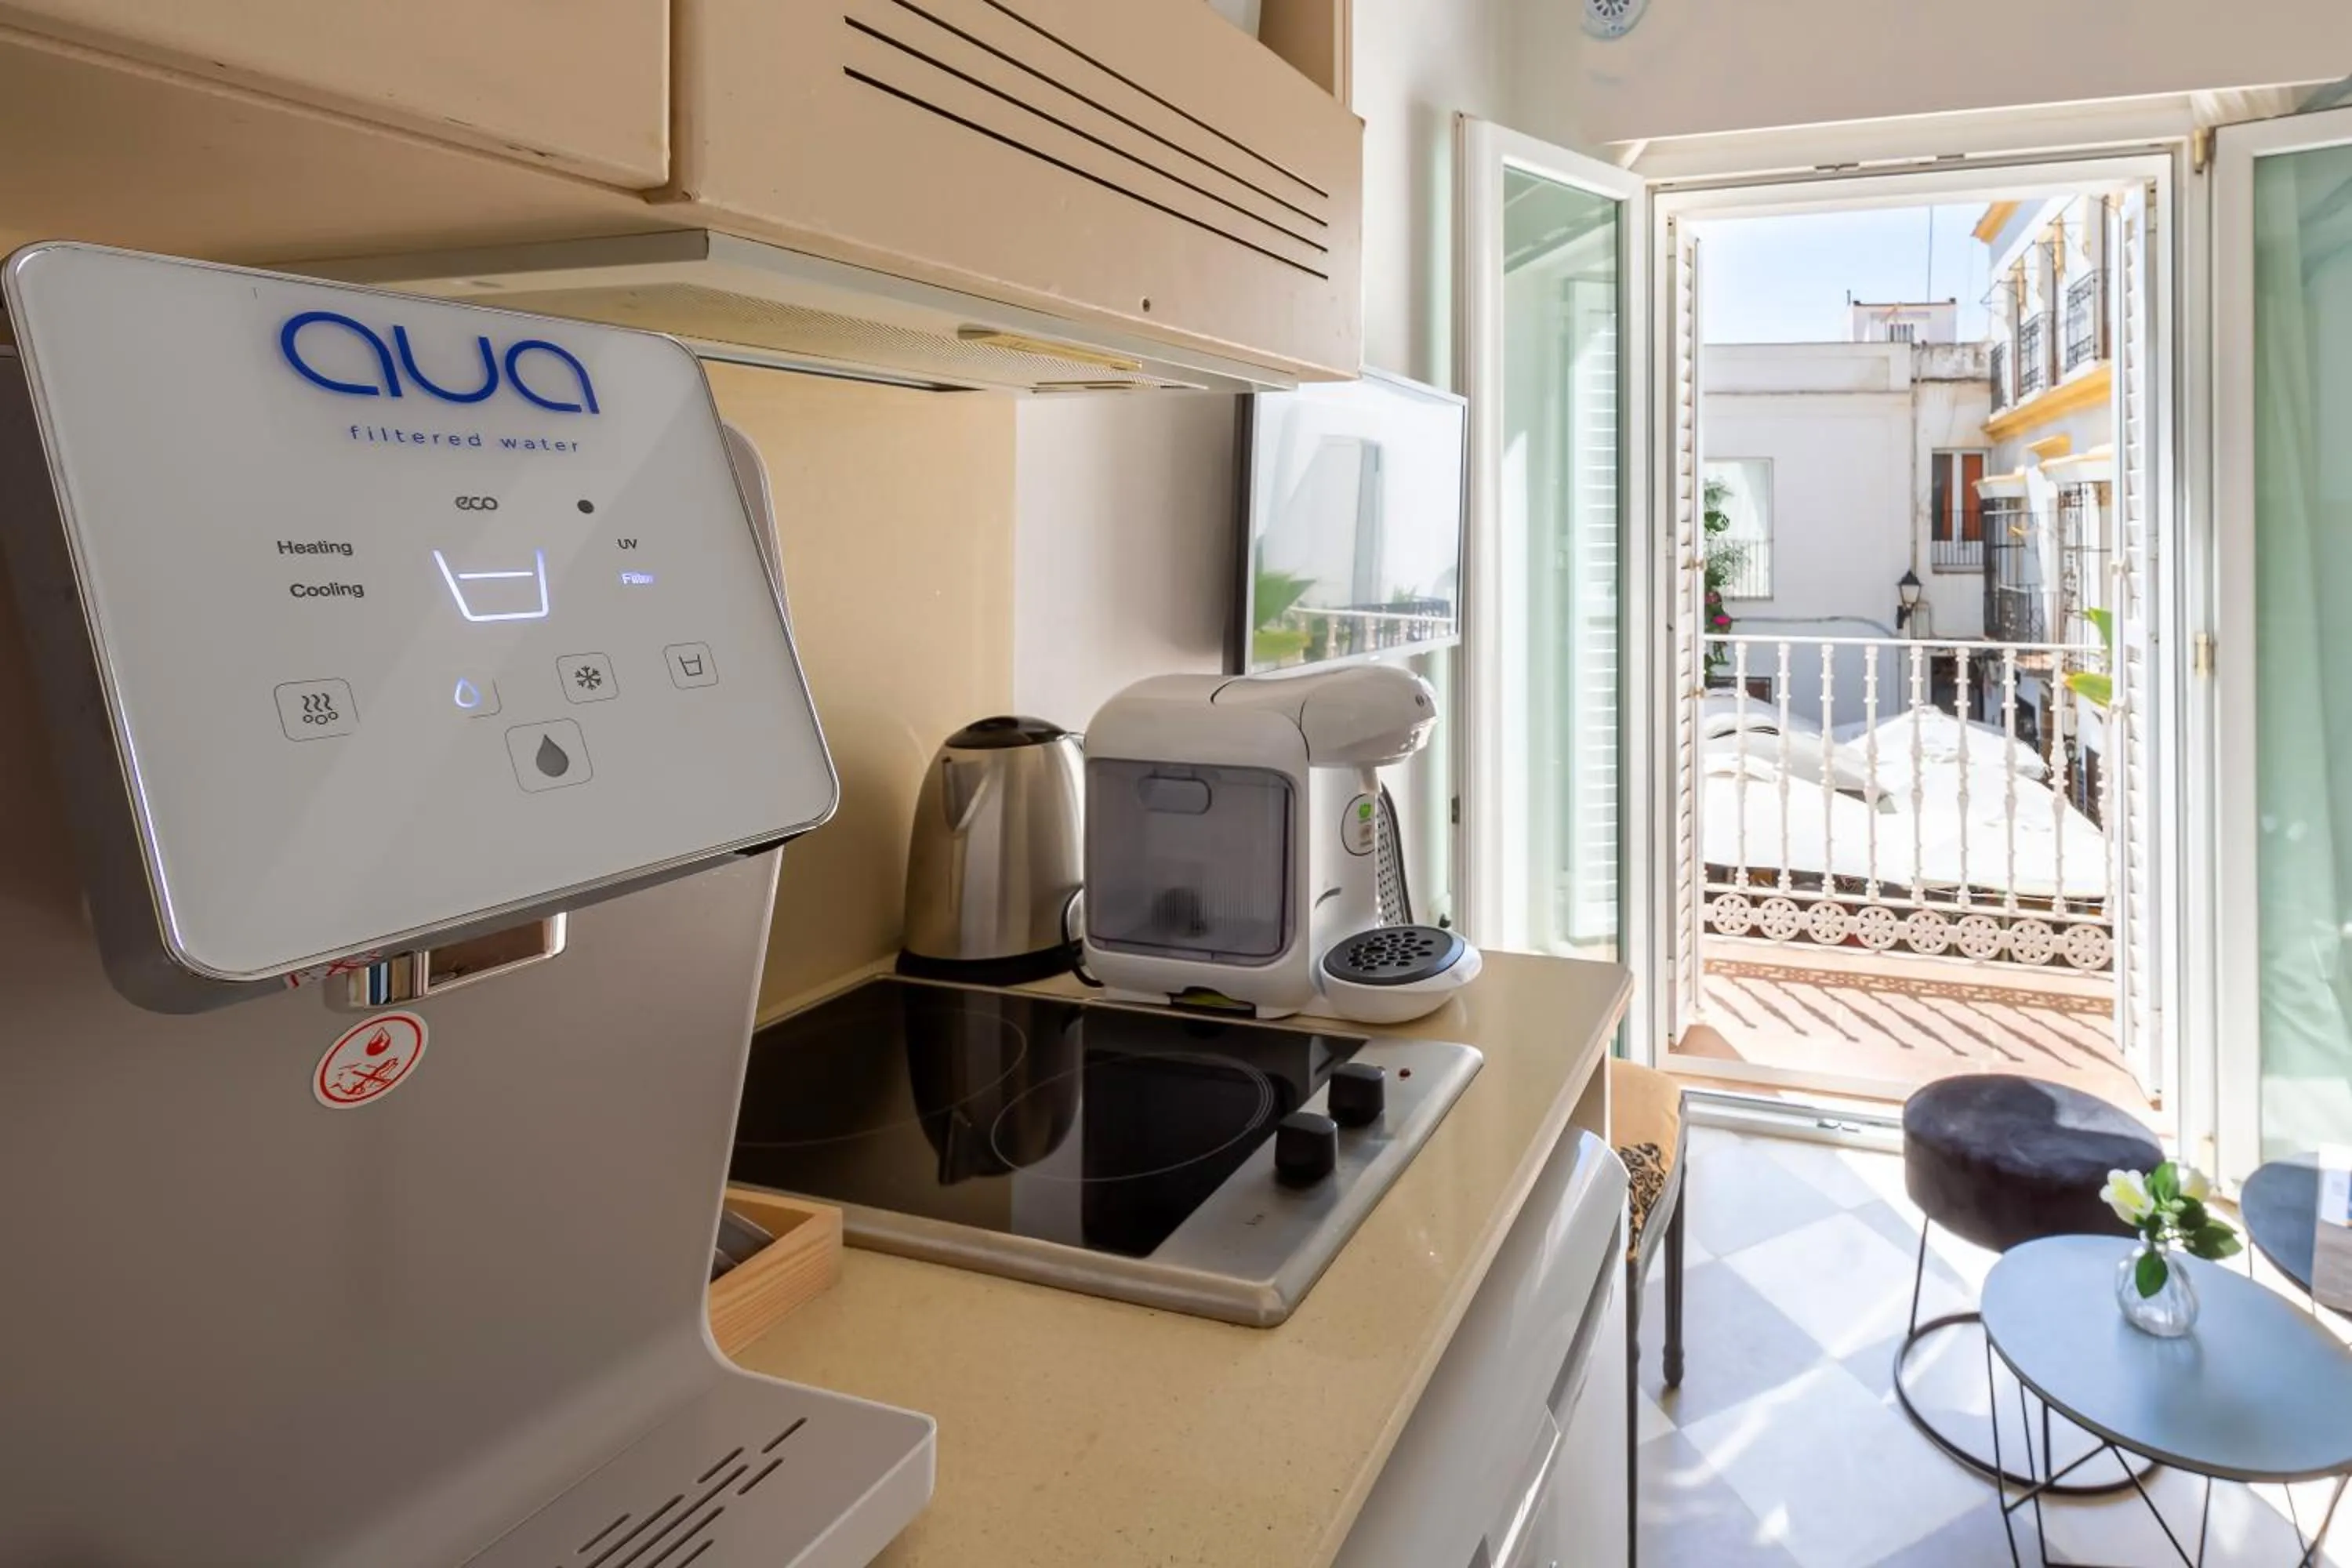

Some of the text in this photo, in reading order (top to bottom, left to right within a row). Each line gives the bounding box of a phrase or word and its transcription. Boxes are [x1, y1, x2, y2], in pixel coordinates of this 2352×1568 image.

[350, 424, 578, 452] filtered water
[455, 495, 498, 510] eco
[277, 539, 353, 556] Heating
[617, 539, 637, 549] UV
[289, 583, 365, 598] Cooling
